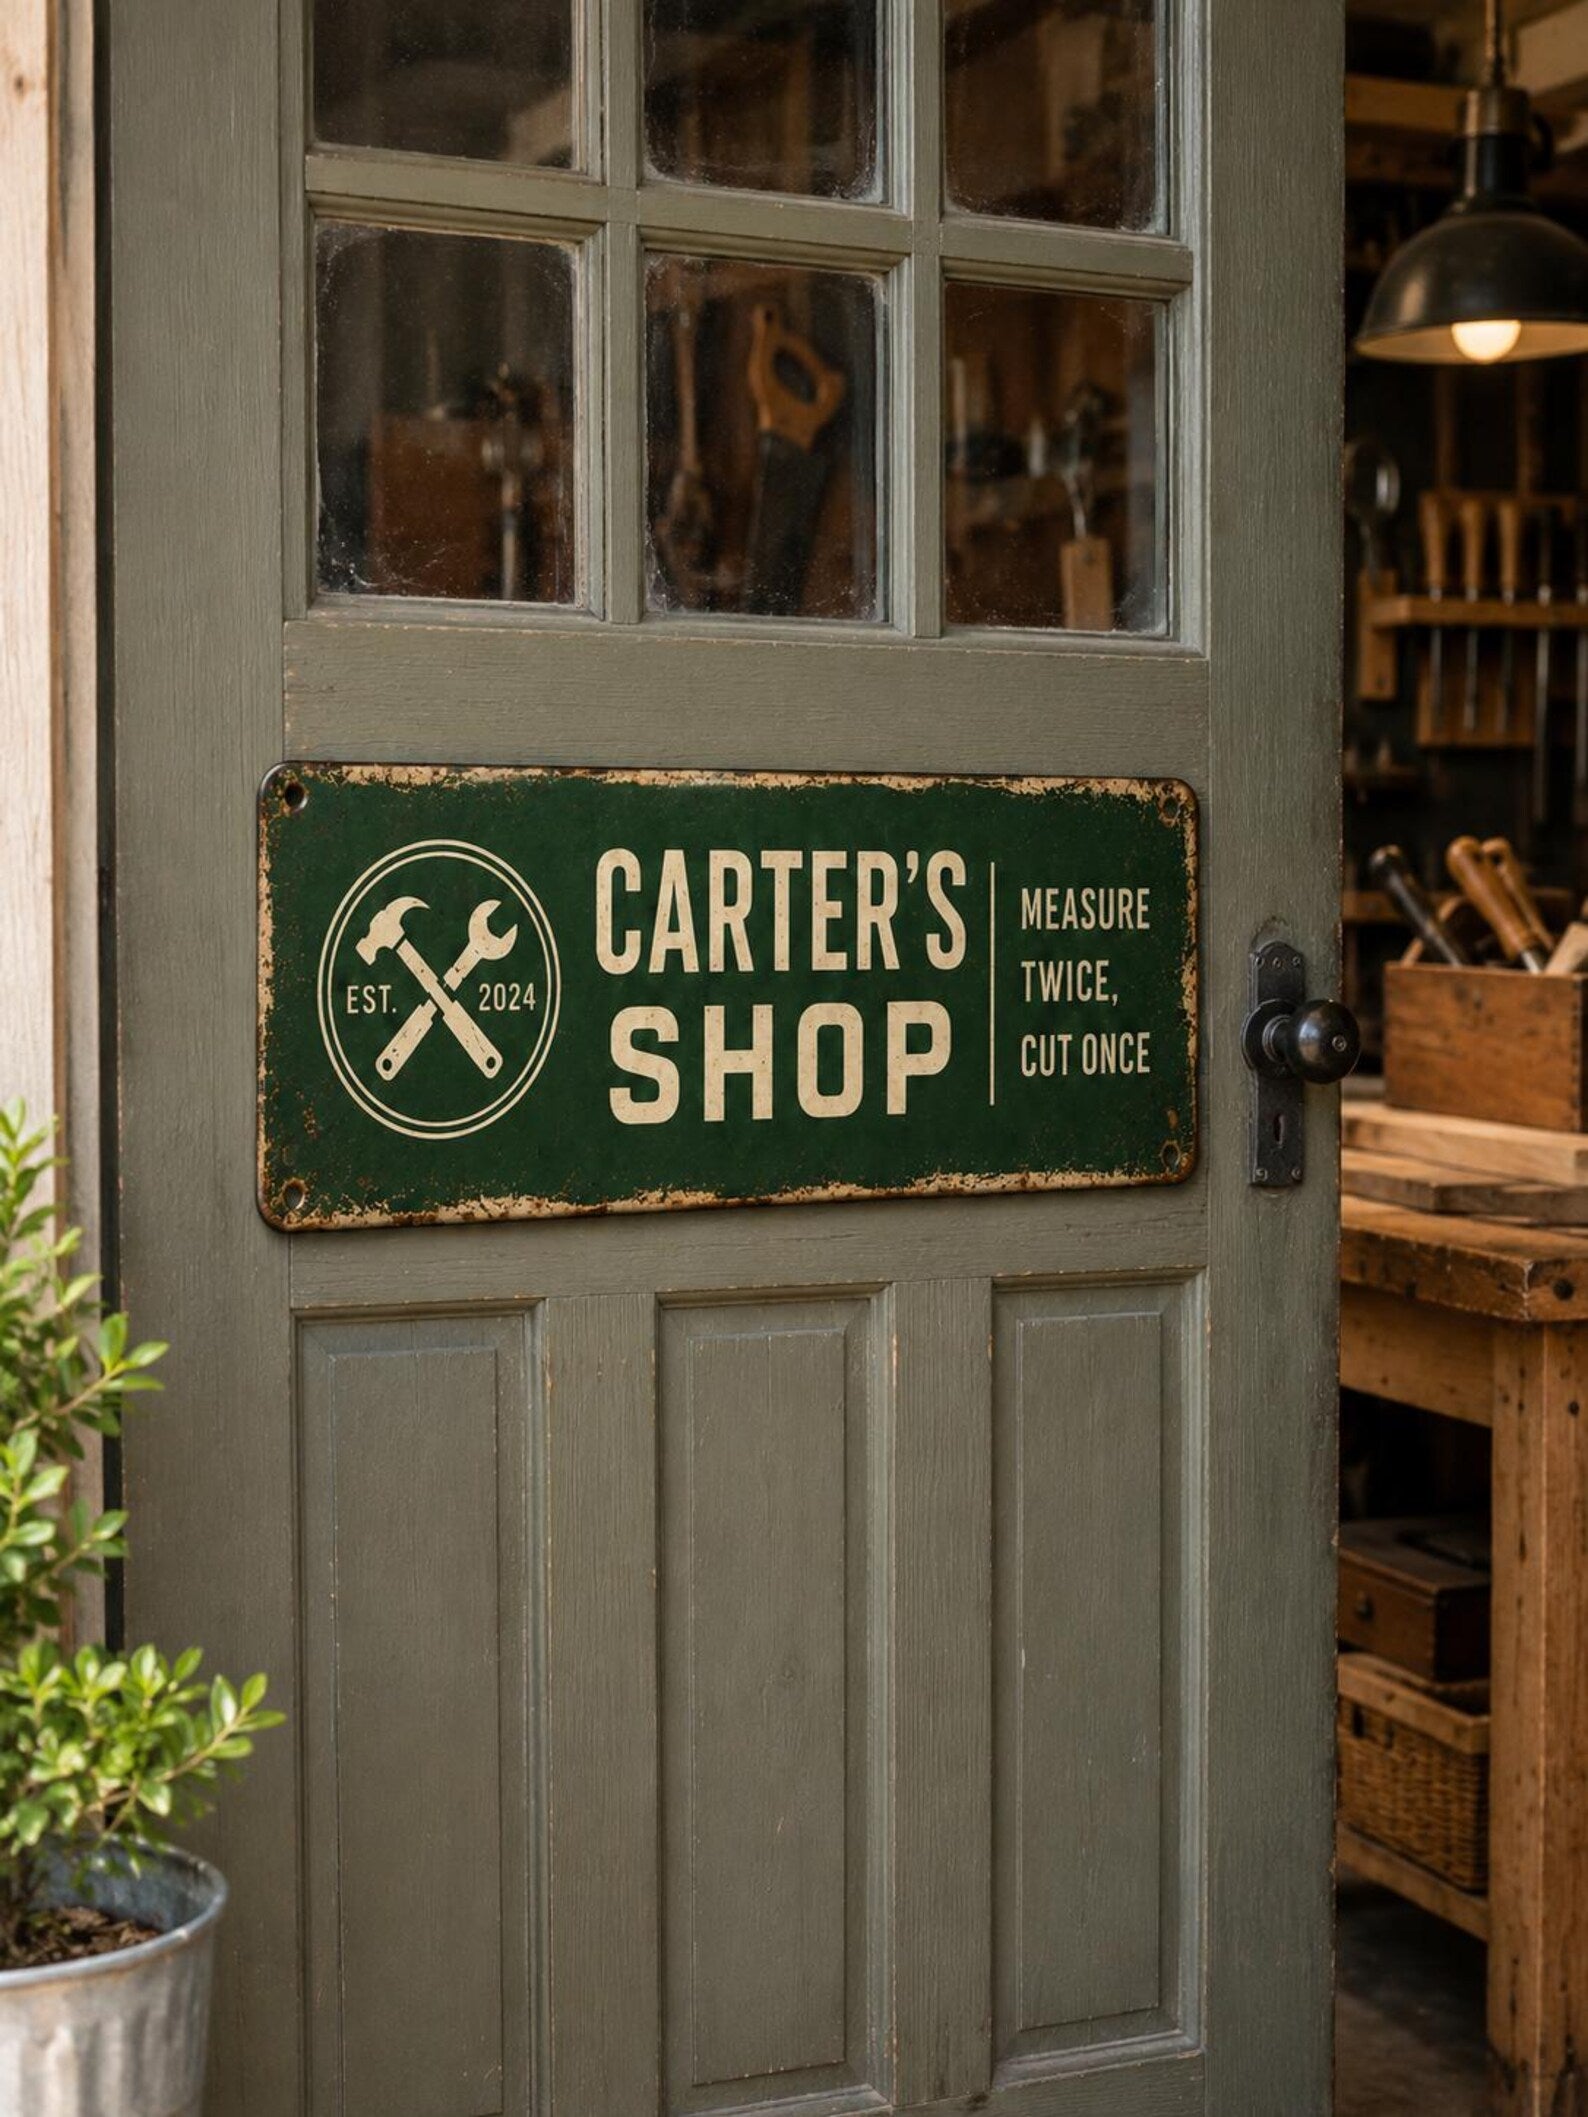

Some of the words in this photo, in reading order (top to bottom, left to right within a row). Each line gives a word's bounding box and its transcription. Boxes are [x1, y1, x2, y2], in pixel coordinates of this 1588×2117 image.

[595, 848, 967, 976] CARTER’S
[1020, 886, 1151, 931] MEASURE
[346, 983, 397, 1015] EST.
[478, 982, 537, 1012] 2024
[1020, 959, 1119, 1007] TWICE,
[609, 1001, 952, 1126] SHOP
[1020, 1033, 1074, 1078] CUT
[1081, 1030, 1151, 1076] ONCE
